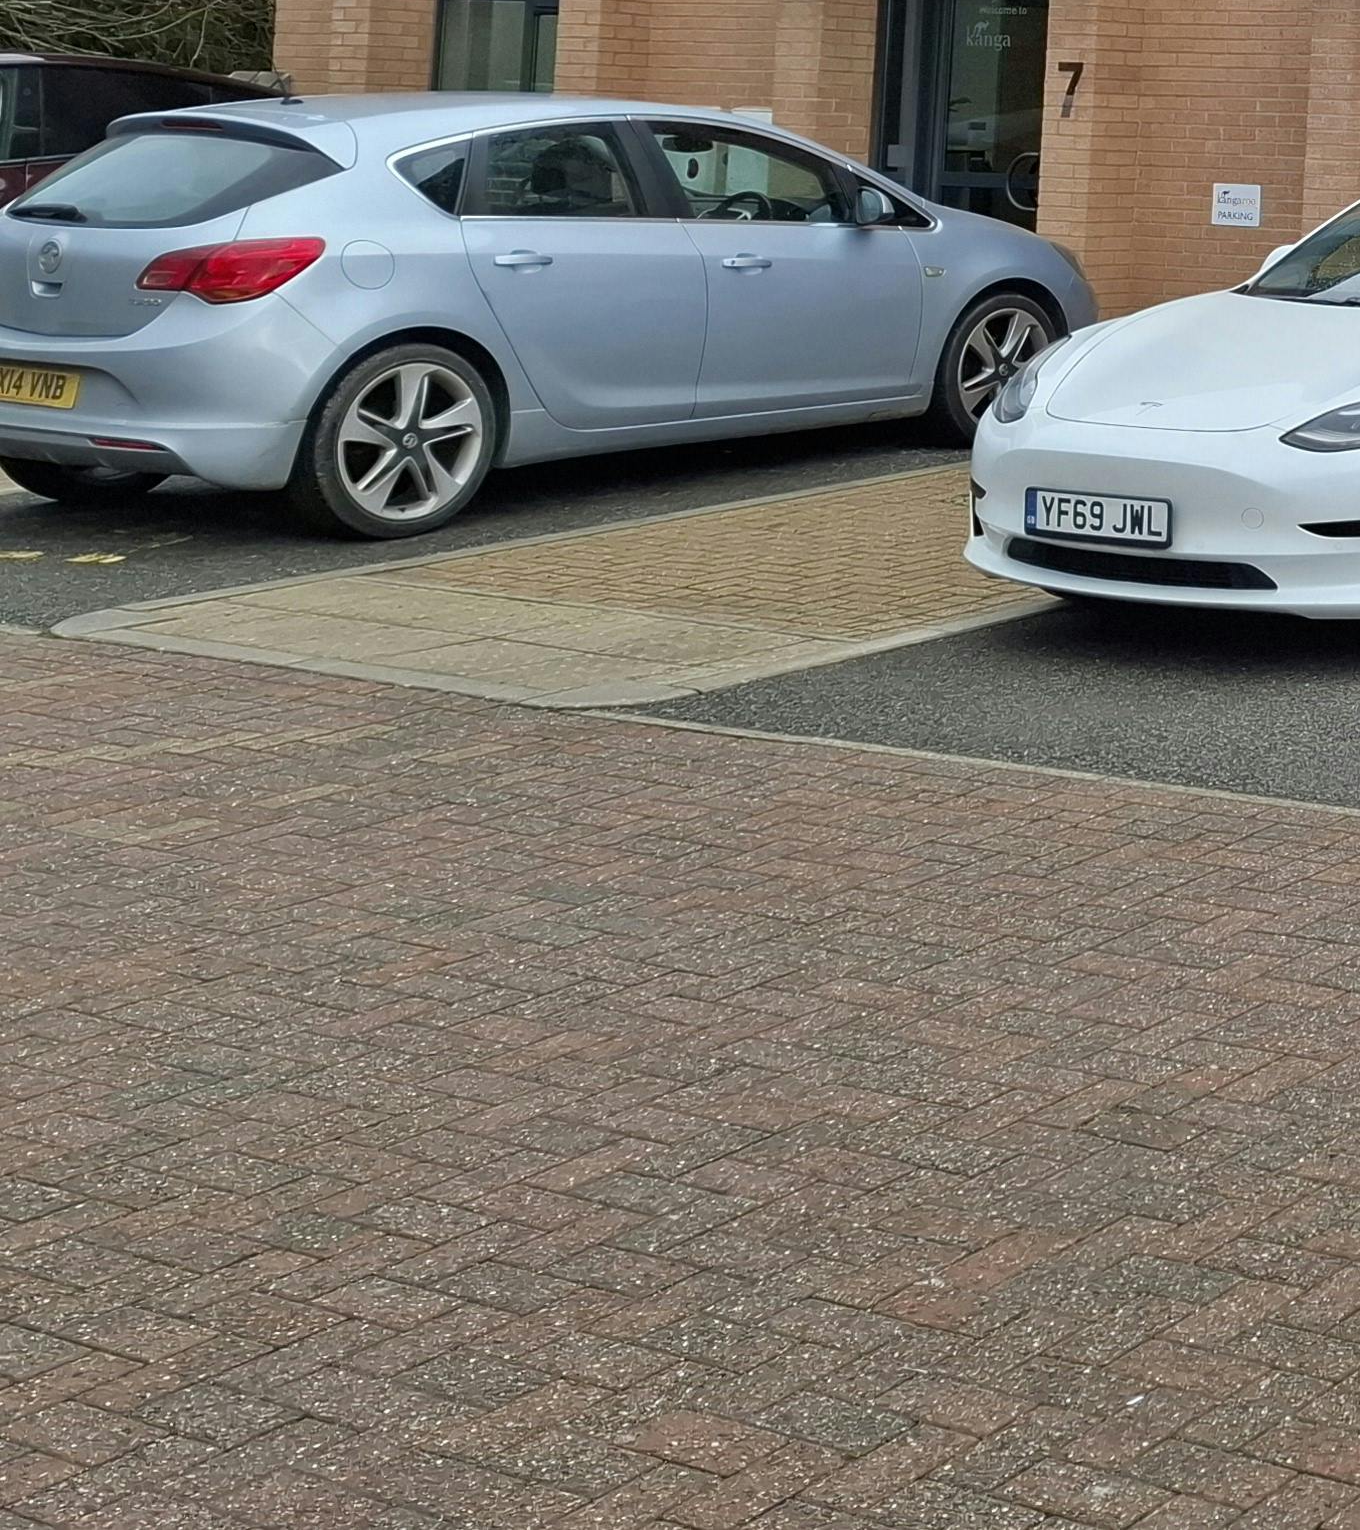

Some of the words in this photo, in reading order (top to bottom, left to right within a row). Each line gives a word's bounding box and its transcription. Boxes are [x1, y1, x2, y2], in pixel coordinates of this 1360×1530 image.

[966, 26, 1011, 51] kanga
[1058, 62, 1084, 118] 7
[1217, 211, 1254, 221] PARKING
[29, 372, 66, 399] VNB
[1042, 495, 1104, 531] YF69
[1112, 503, 1162, 537] JWL
